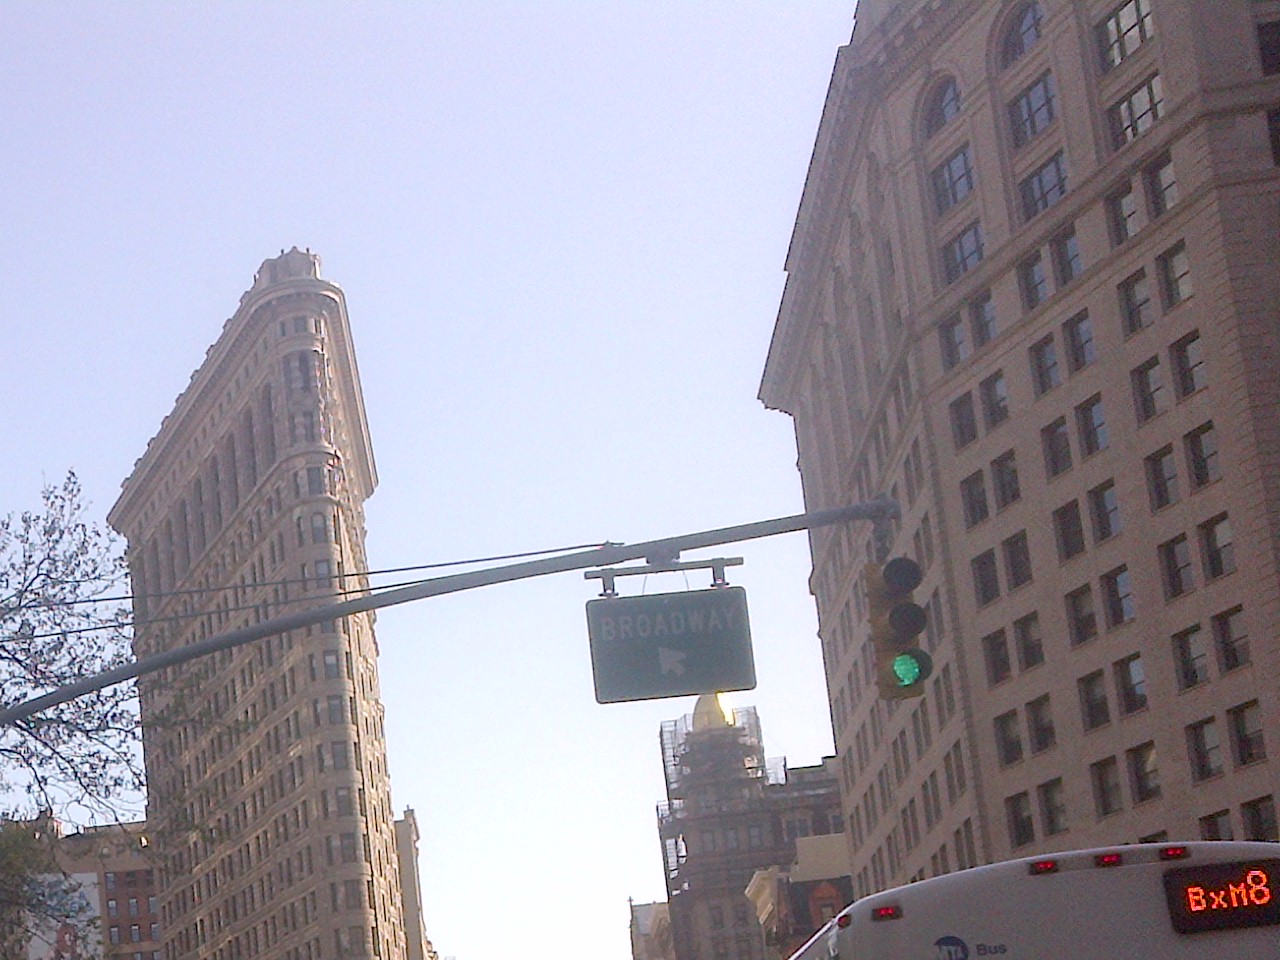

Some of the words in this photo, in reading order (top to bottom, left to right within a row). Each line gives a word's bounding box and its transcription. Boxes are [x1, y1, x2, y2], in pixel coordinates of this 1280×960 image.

[600, 604, 737, 641] BROADWAY
[1186, 869, 1272, 912] BxM8
[976, 943, 1007, 956] Bus
